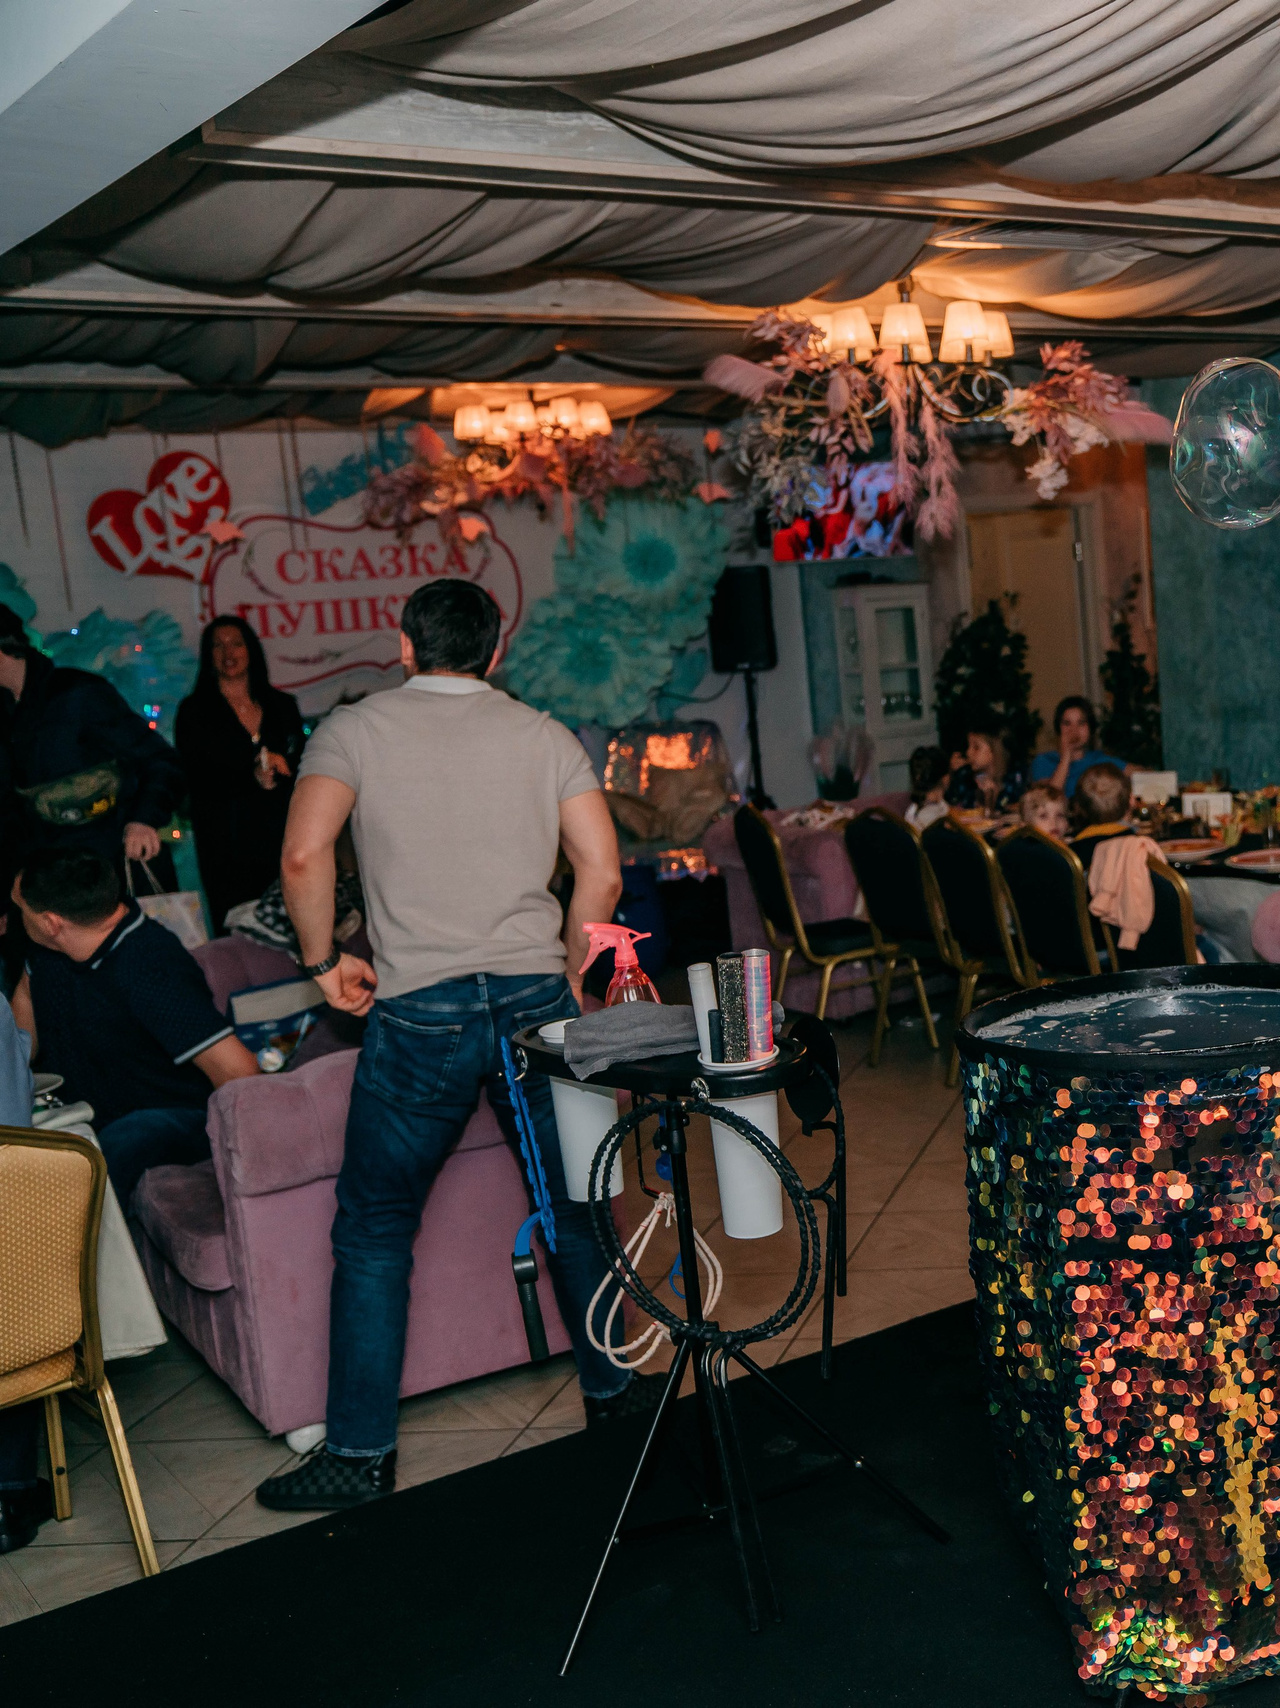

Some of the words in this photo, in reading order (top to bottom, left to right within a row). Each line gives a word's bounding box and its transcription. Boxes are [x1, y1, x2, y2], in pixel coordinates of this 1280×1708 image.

[91, 457, 221, 576] Love
[275, 543, 471, 585] СКАЗКА
[233, 587, 507, 639] ПУШК
